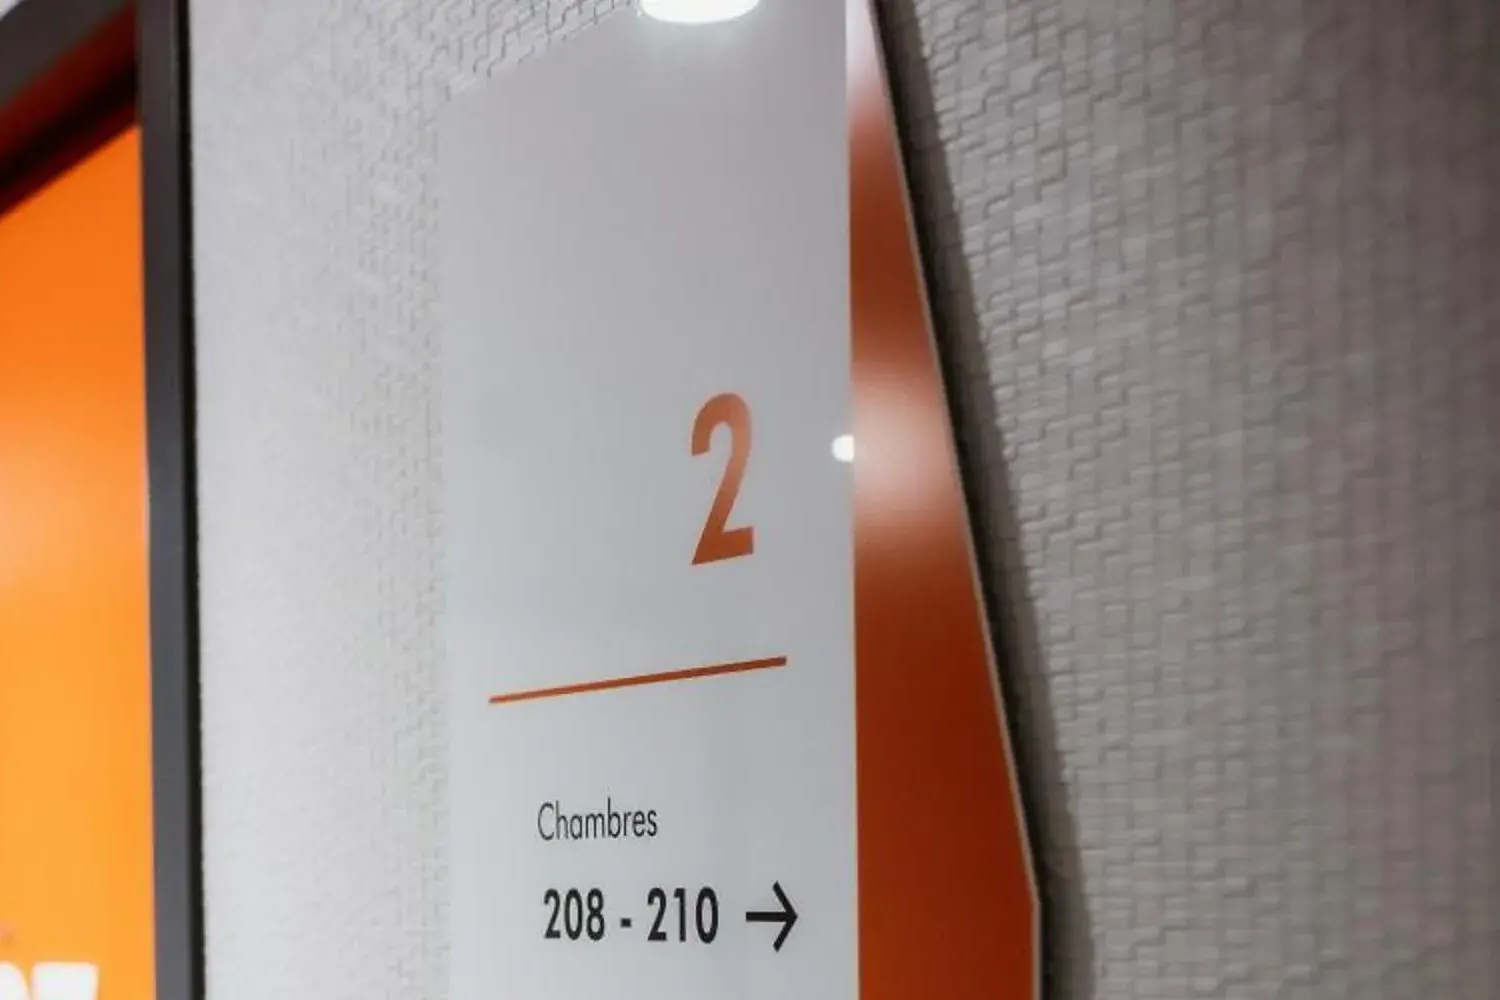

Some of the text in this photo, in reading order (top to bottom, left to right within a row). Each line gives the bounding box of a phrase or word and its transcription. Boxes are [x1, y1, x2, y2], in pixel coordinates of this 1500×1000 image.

[689, 392, 756, 567] 2
[536, 797, 659, 842] Chambres
[542, 886, 719, 945] 208 - 210
